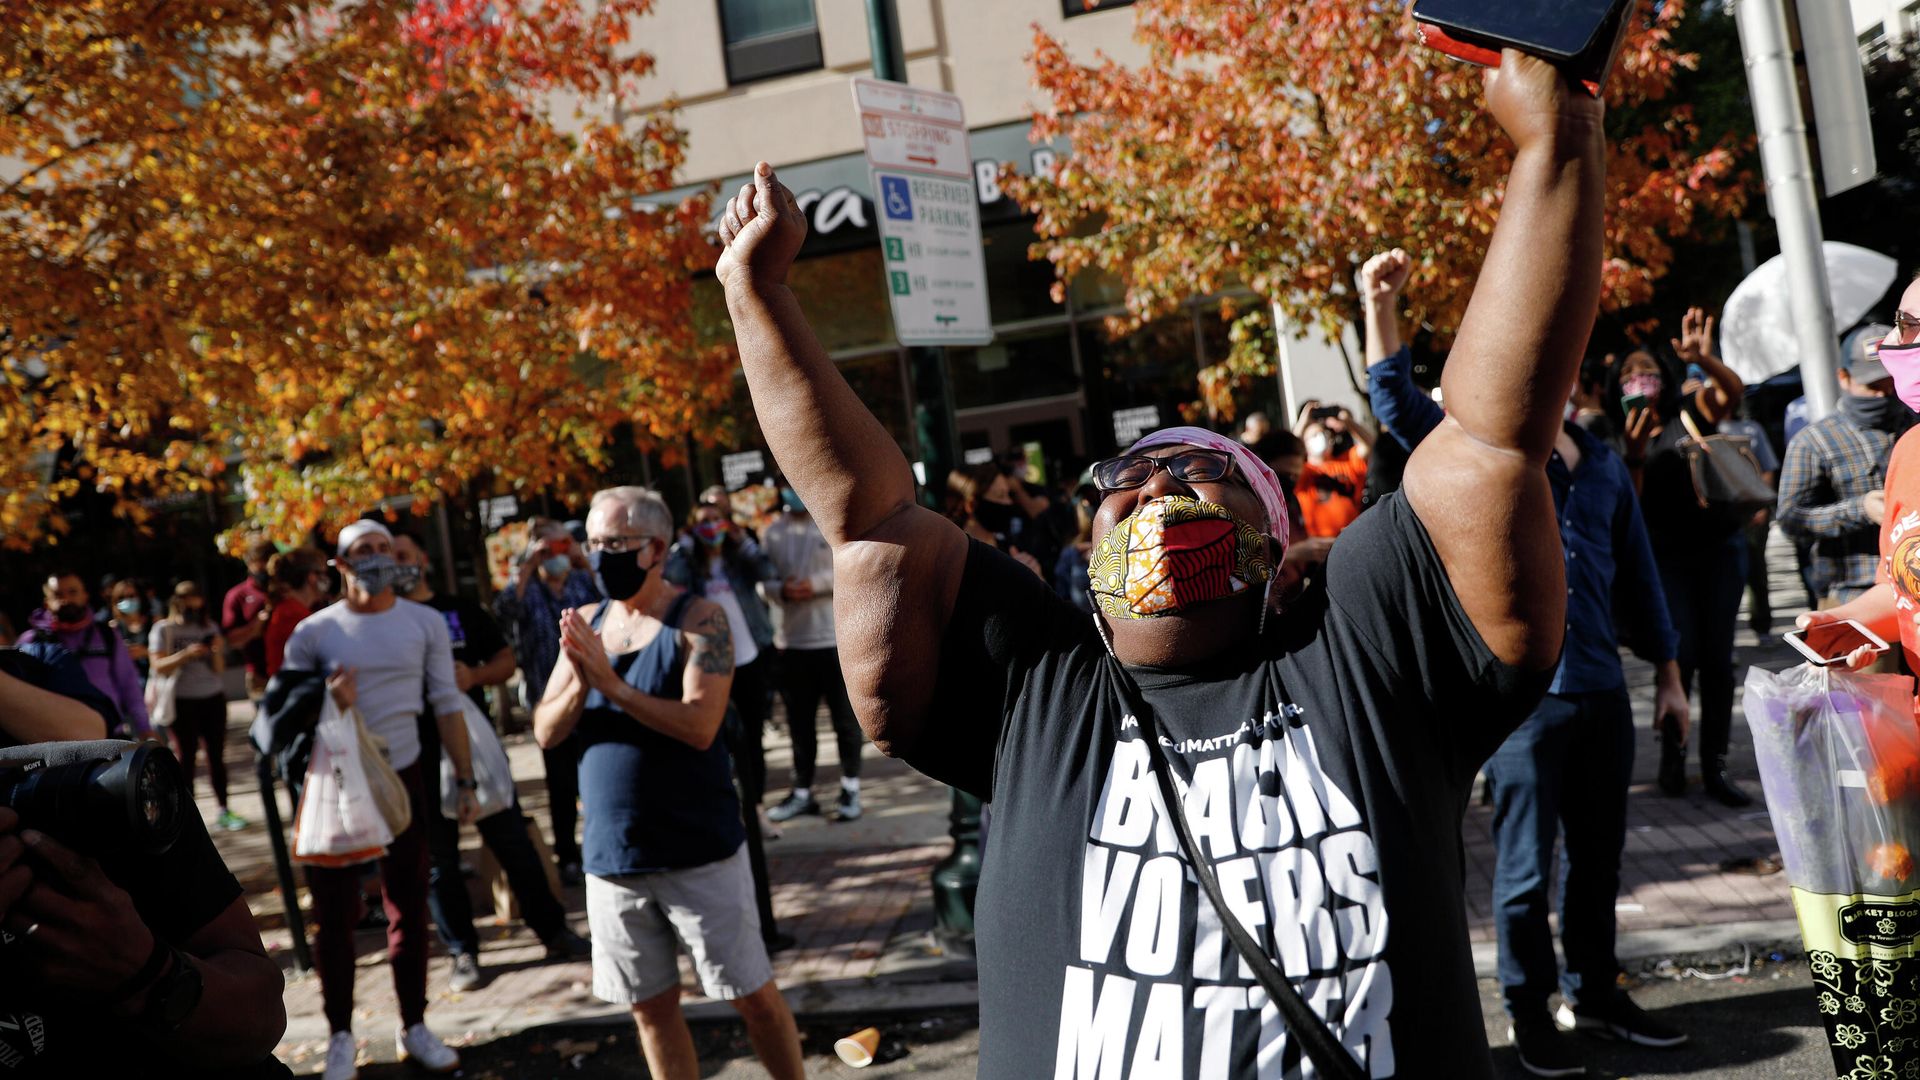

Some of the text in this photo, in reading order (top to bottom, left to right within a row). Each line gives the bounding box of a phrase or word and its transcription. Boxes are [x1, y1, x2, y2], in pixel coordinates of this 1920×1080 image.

[886, 119, 953, 145] STOPPING
[912, 179, 970, 205] RESERVED
[919, 205, 971, 229] PARKING
[24, 759, 41, 772] SONY
[1080, 830, 1389, 981] VOTERS
